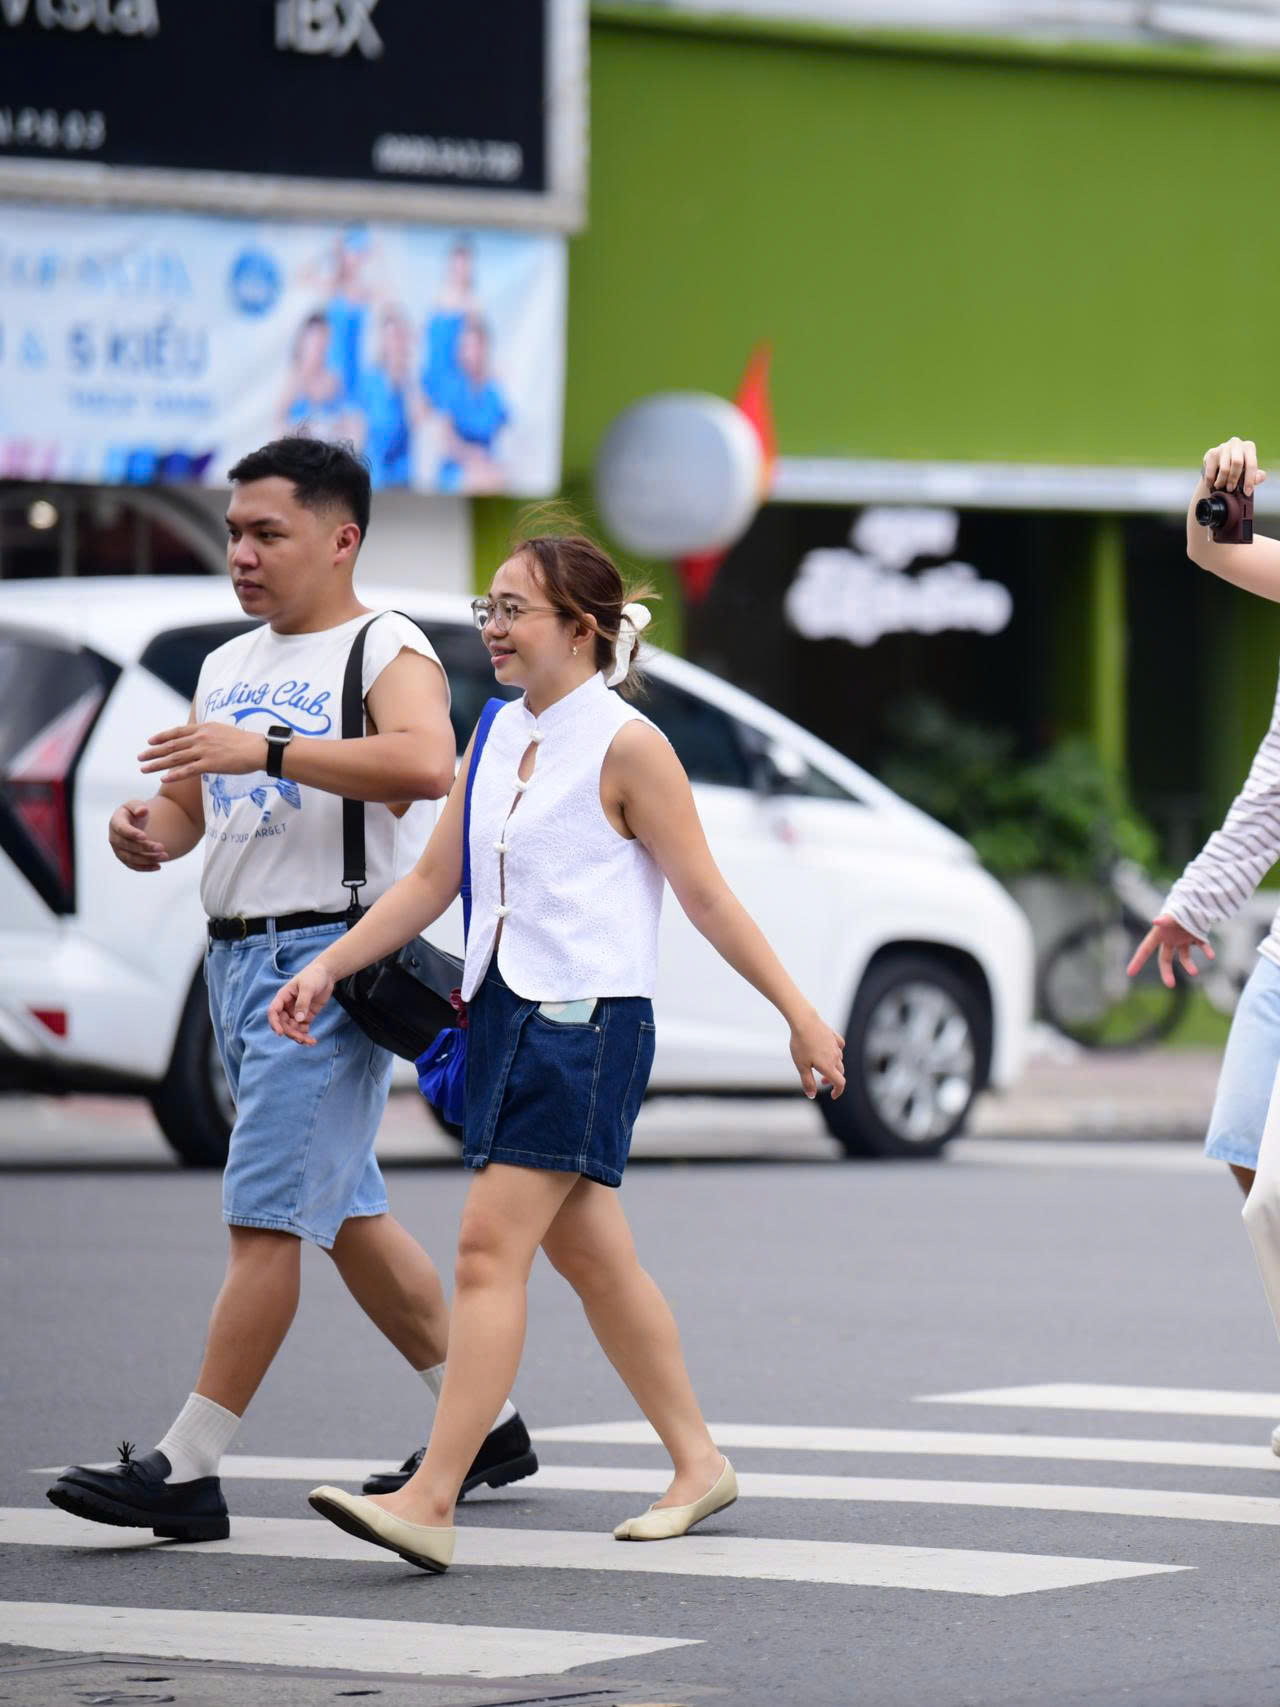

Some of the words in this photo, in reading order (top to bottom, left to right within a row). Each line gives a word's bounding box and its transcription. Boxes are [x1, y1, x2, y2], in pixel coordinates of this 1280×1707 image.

[203, 682, 270, 720] Fishing
[272, 680, 331, 716] Club
[253, 822, 288, 840] ARGET
